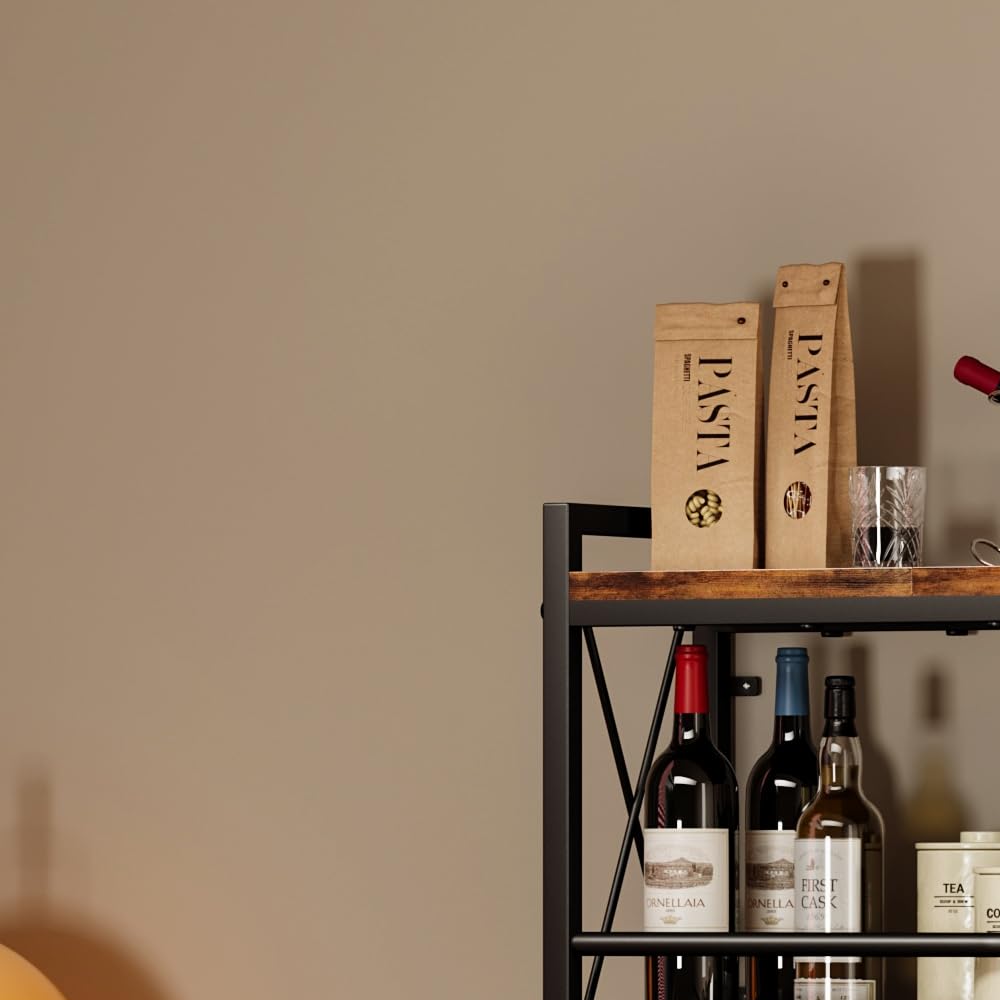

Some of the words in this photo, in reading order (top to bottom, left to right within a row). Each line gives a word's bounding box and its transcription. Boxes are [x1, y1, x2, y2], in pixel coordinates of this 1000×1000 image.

[683, 353, 692, 382] SPAGHETTI
[794, 335, 823, 455] PASTA
[697, 357, 733, 471] PASTA
[801, 878, 838, 893] FIRST
[943, 883, 965, 894] TEA
